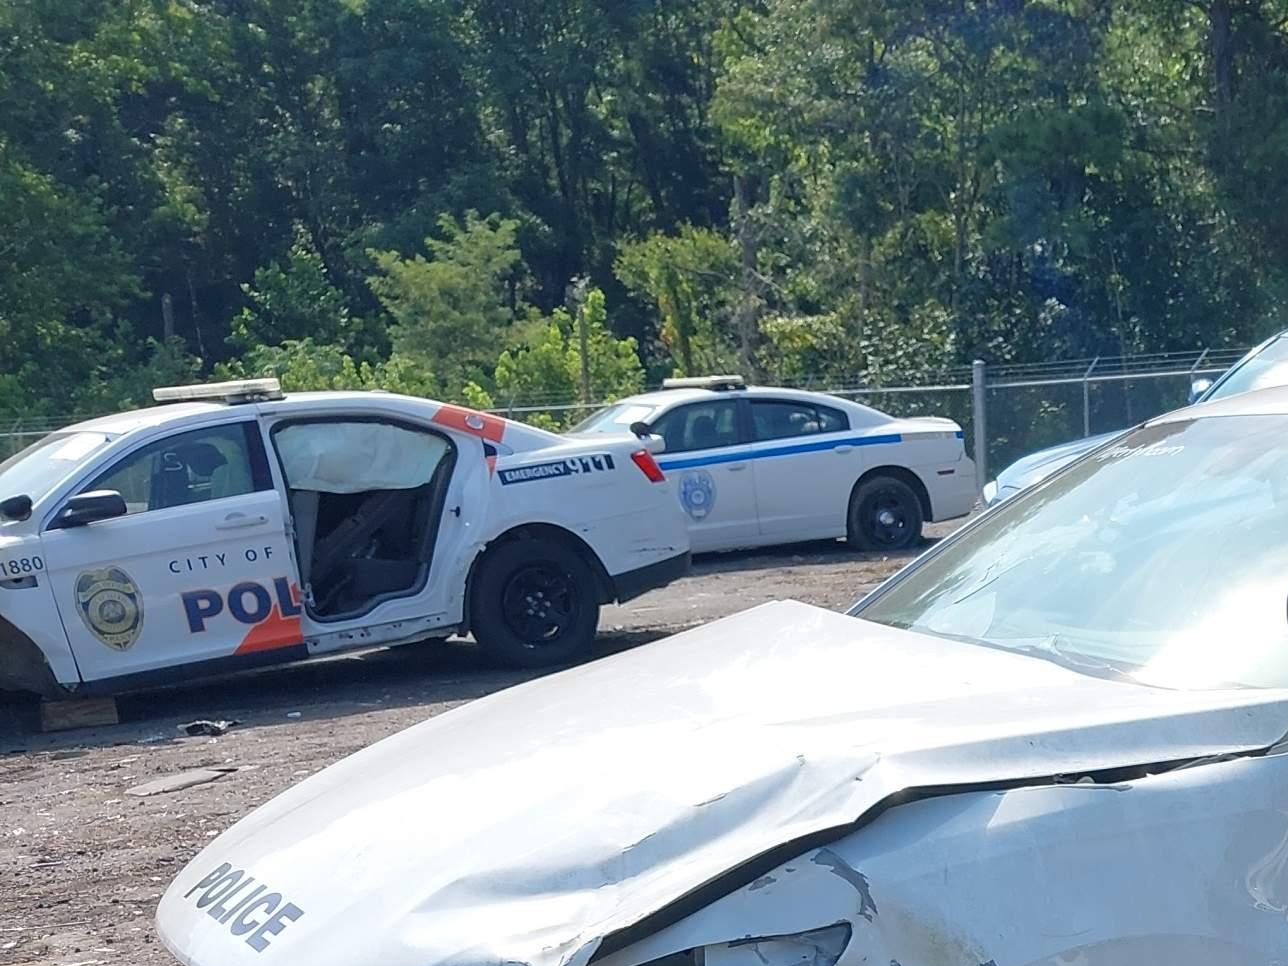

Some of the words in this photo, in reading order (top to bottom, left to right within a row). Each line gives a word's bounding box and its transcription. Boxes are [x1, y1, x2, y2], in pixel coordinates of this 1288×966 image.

[505, 463, 566, 481] EMERGENCY
[0, 555, 44, 576] 1880
[169, 553, 227, 573] CITY
[244, 546, 274, 562] OF
[183, 862, 305, 953] POLICE
